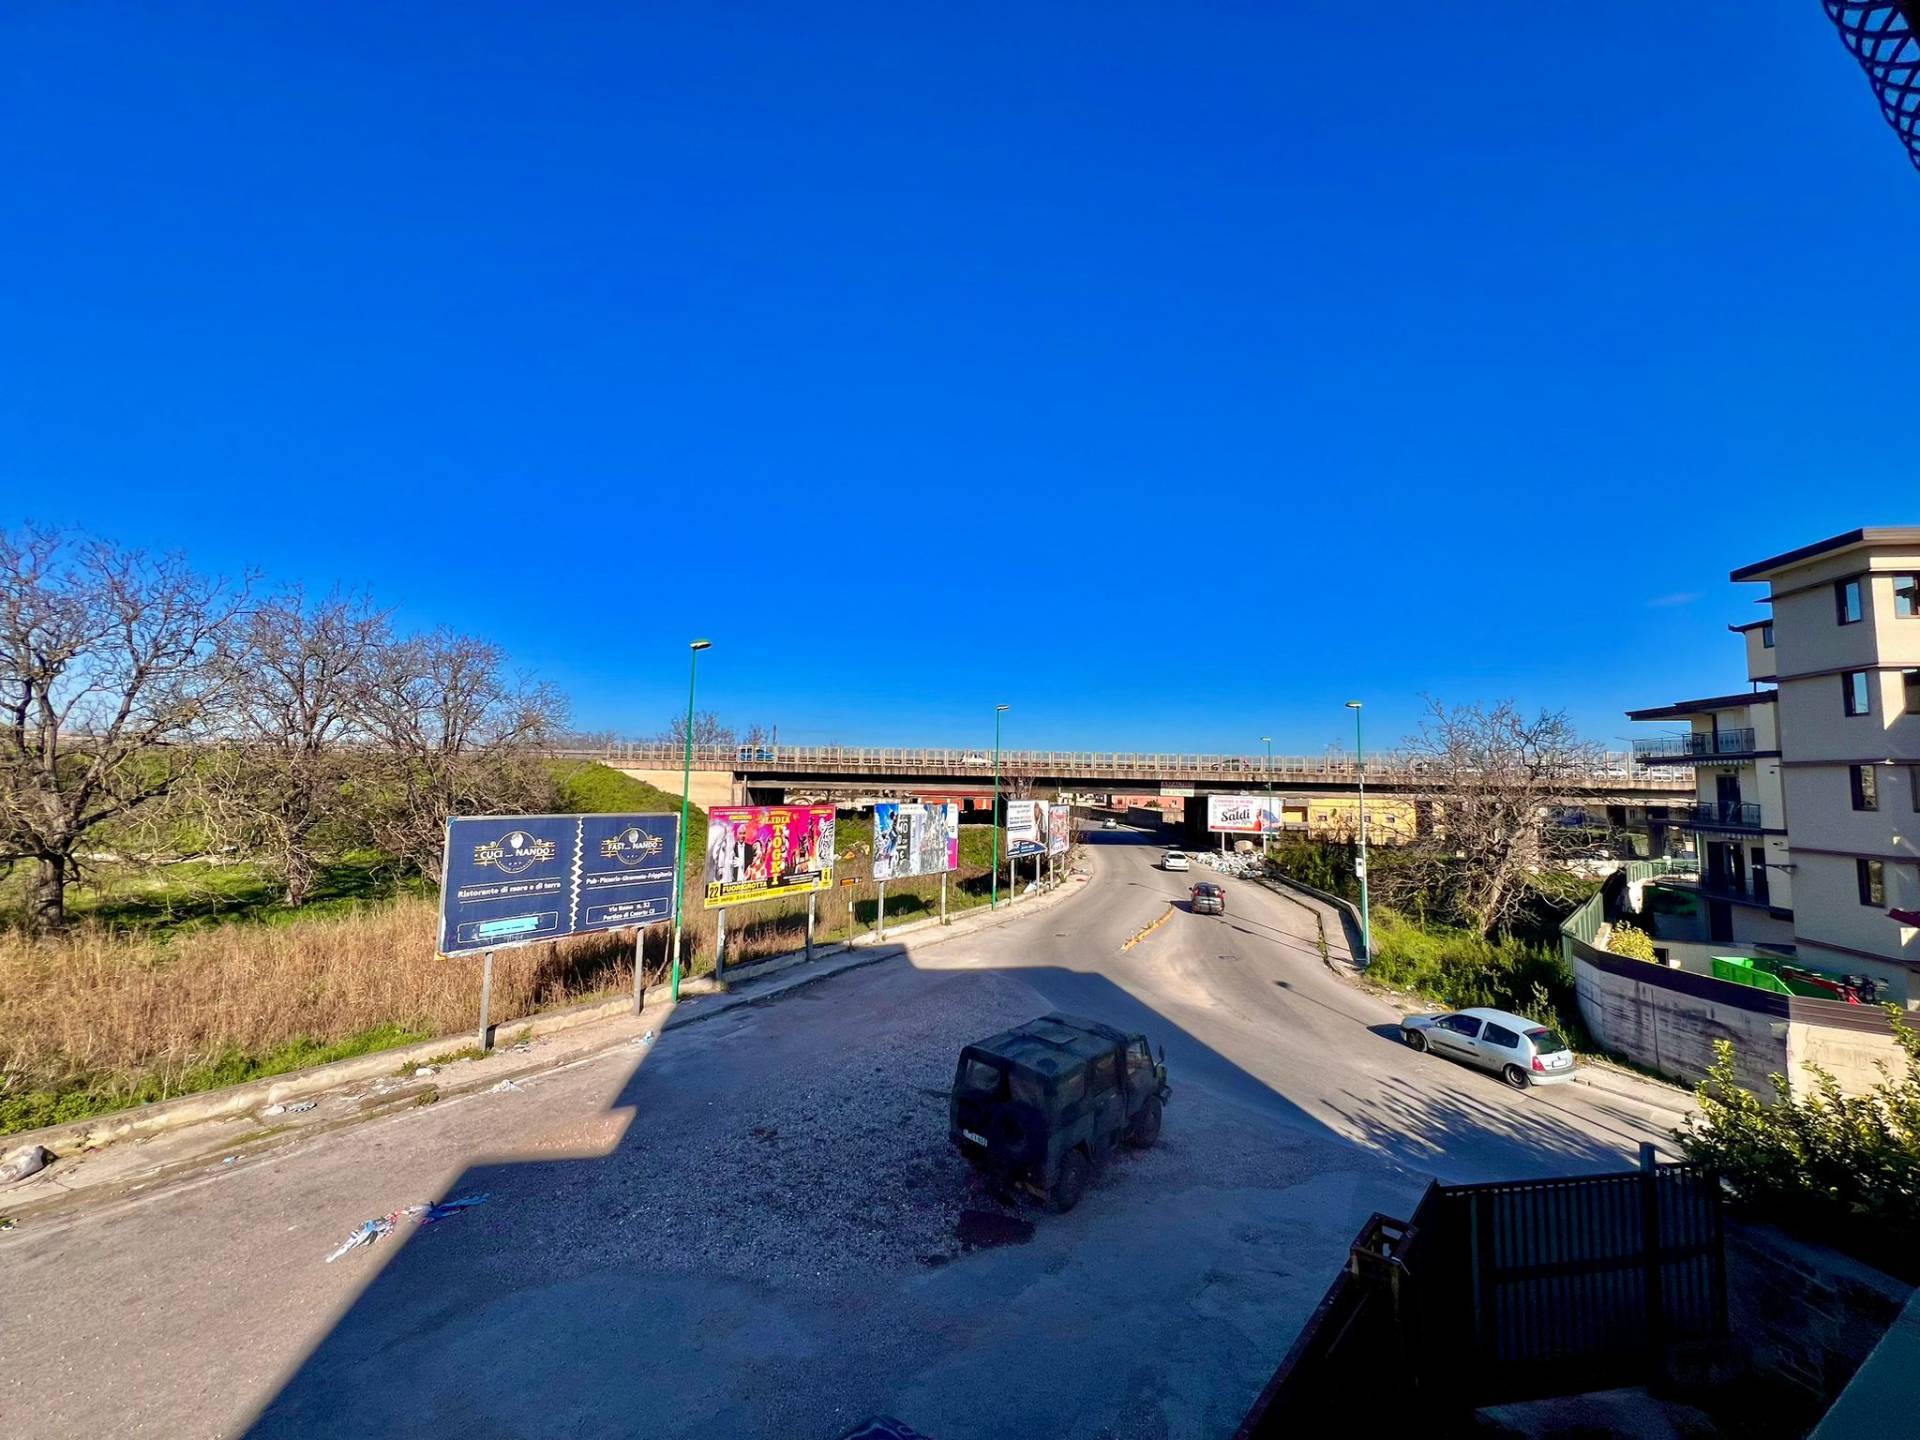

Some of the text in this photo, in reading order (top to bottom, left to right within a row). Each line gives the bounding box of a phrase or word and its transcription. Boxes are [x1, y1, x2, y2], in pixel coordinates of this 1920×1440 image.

[1221, 809, 1250, 822] Saldi
[515, 847, 550, 857] NANDO
[608, 842, 625, 851] FAST
[458, 886, 499, 899] Ristorante
[500, 885, 508, 894] di
[509, 884, 528, 893] mare
[535, 882, 543, 891] di
[544, 881, 561, 890] terra
[709, 886, 719, 899] 22
[608, 905, 617, 913] Via
